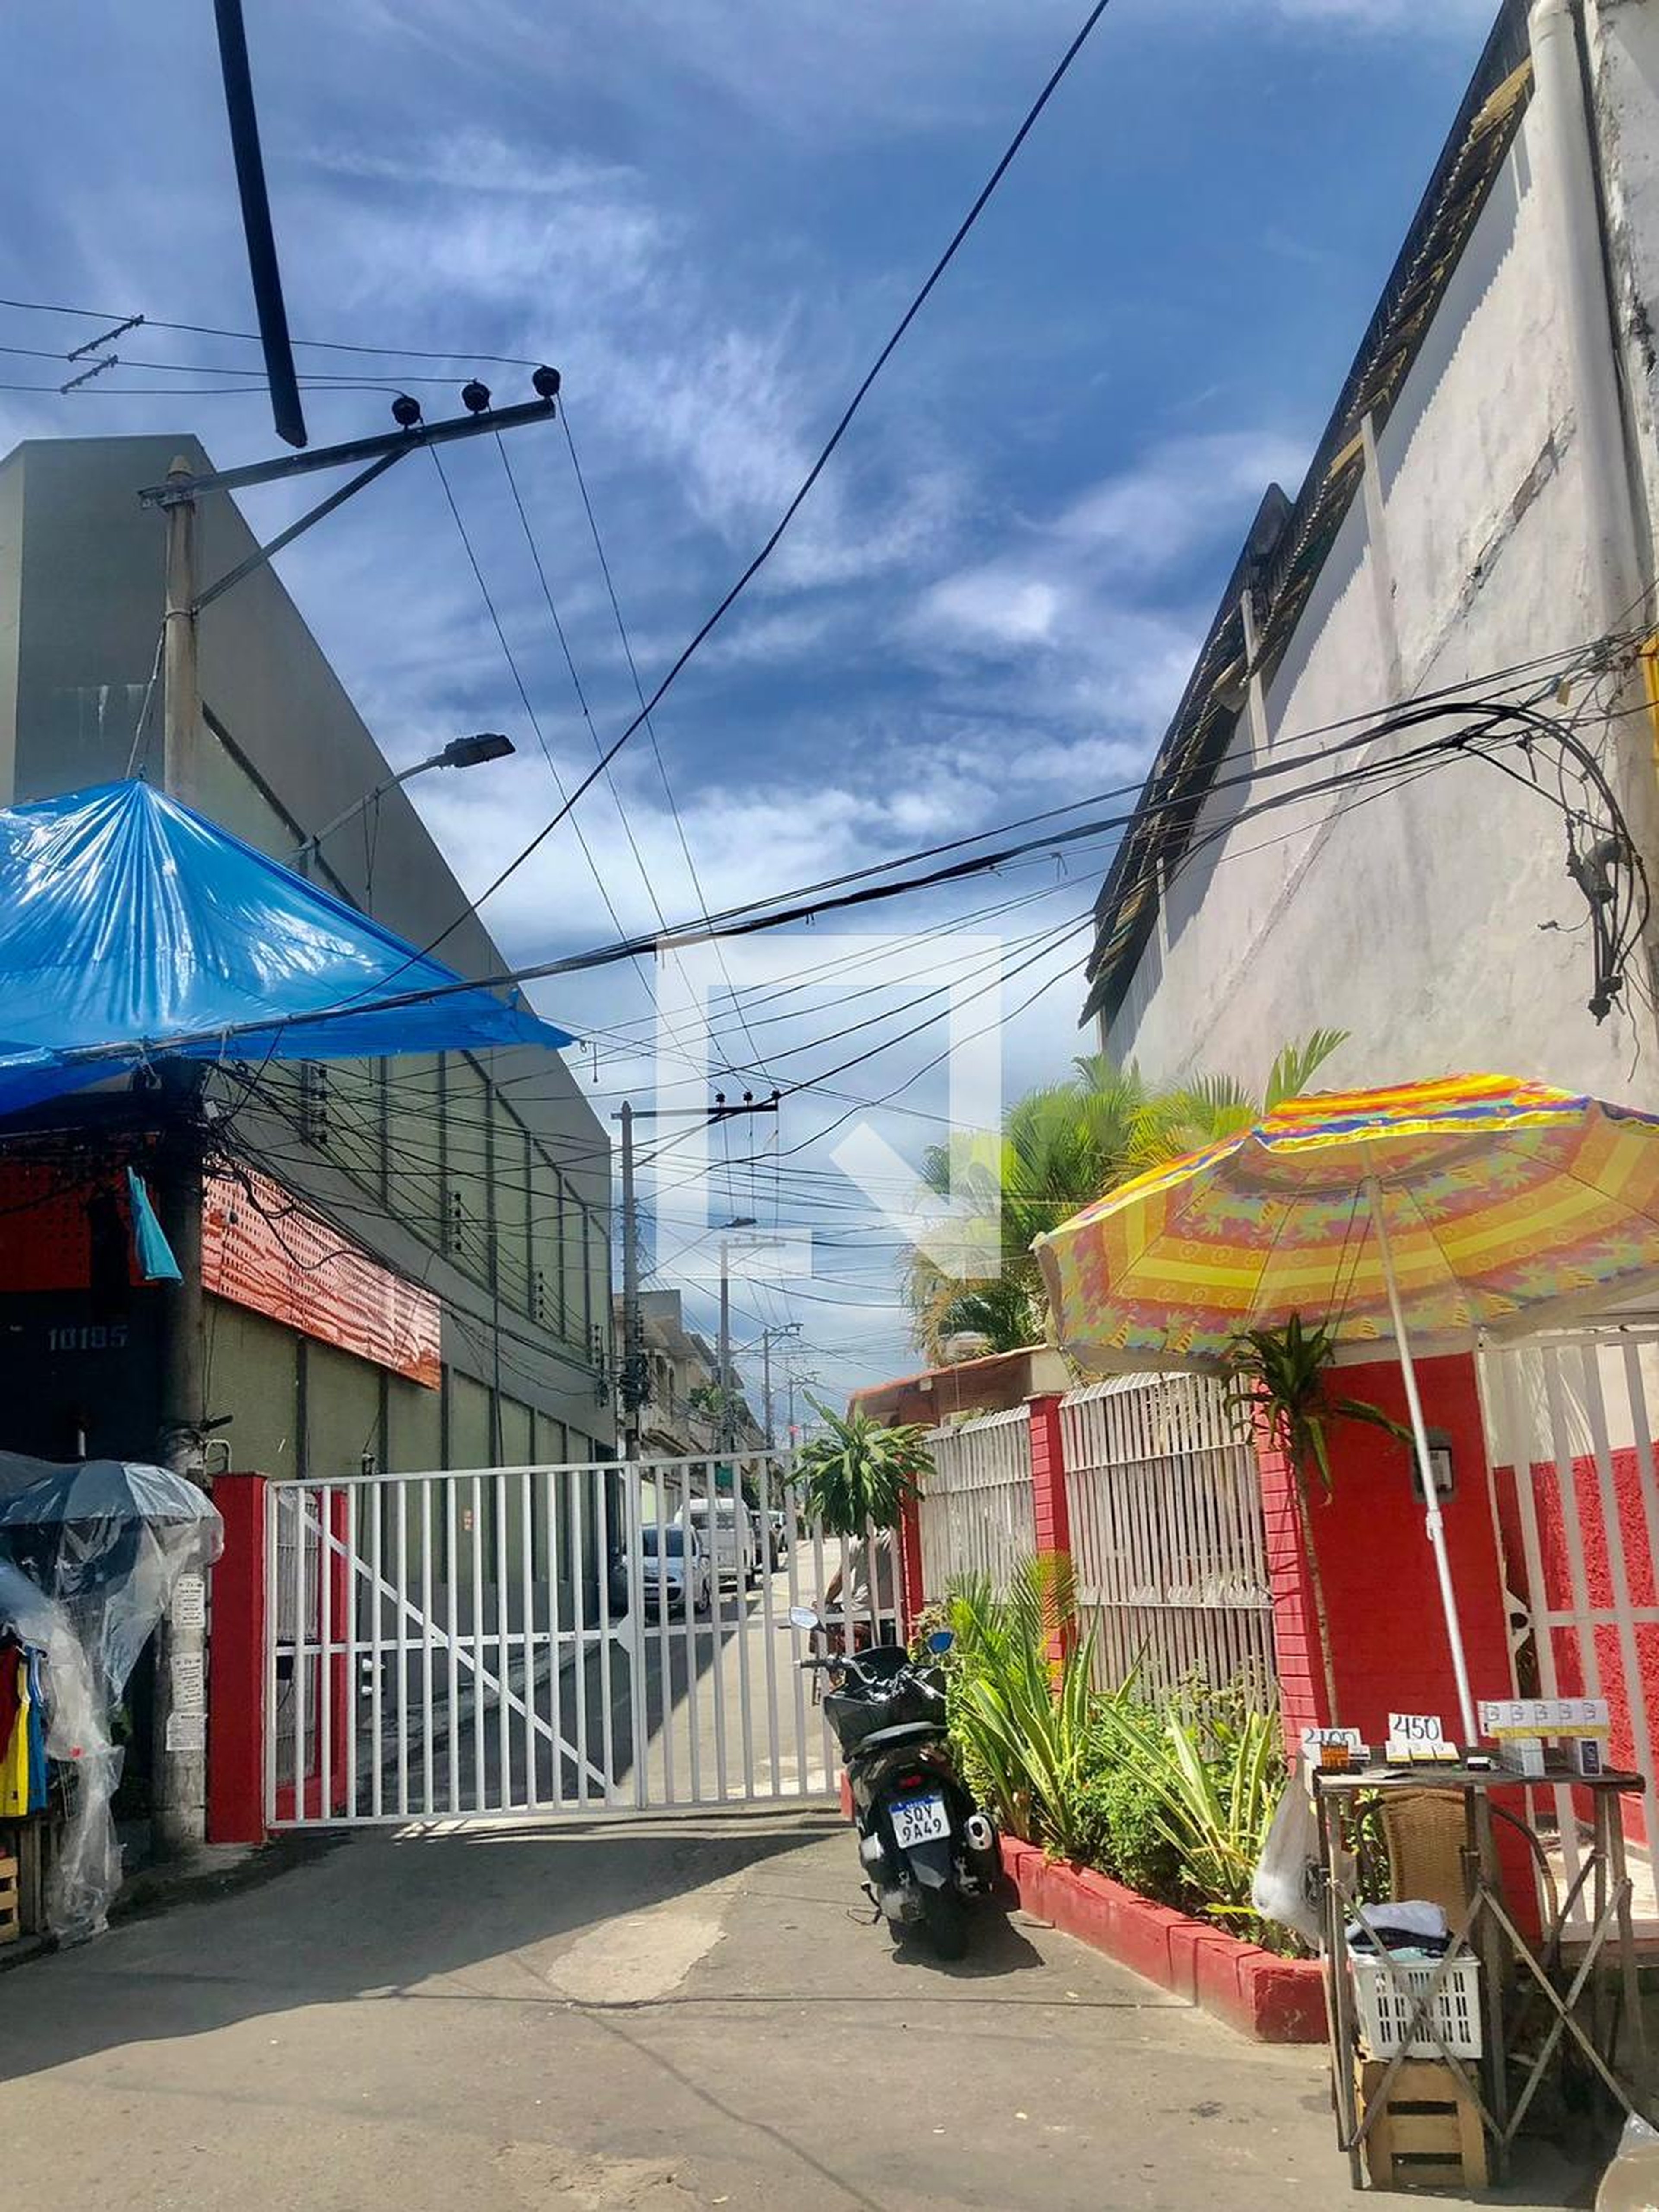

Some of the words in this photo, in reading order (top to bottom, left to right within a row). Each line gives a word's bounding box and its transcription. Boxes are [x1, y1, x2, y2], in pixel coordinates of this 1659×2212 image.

[1394, 1716, 1440, 1740] 450
[904, 1805, 932, 1824] SQY
[903, 1818, 941, 1841] 9A49
